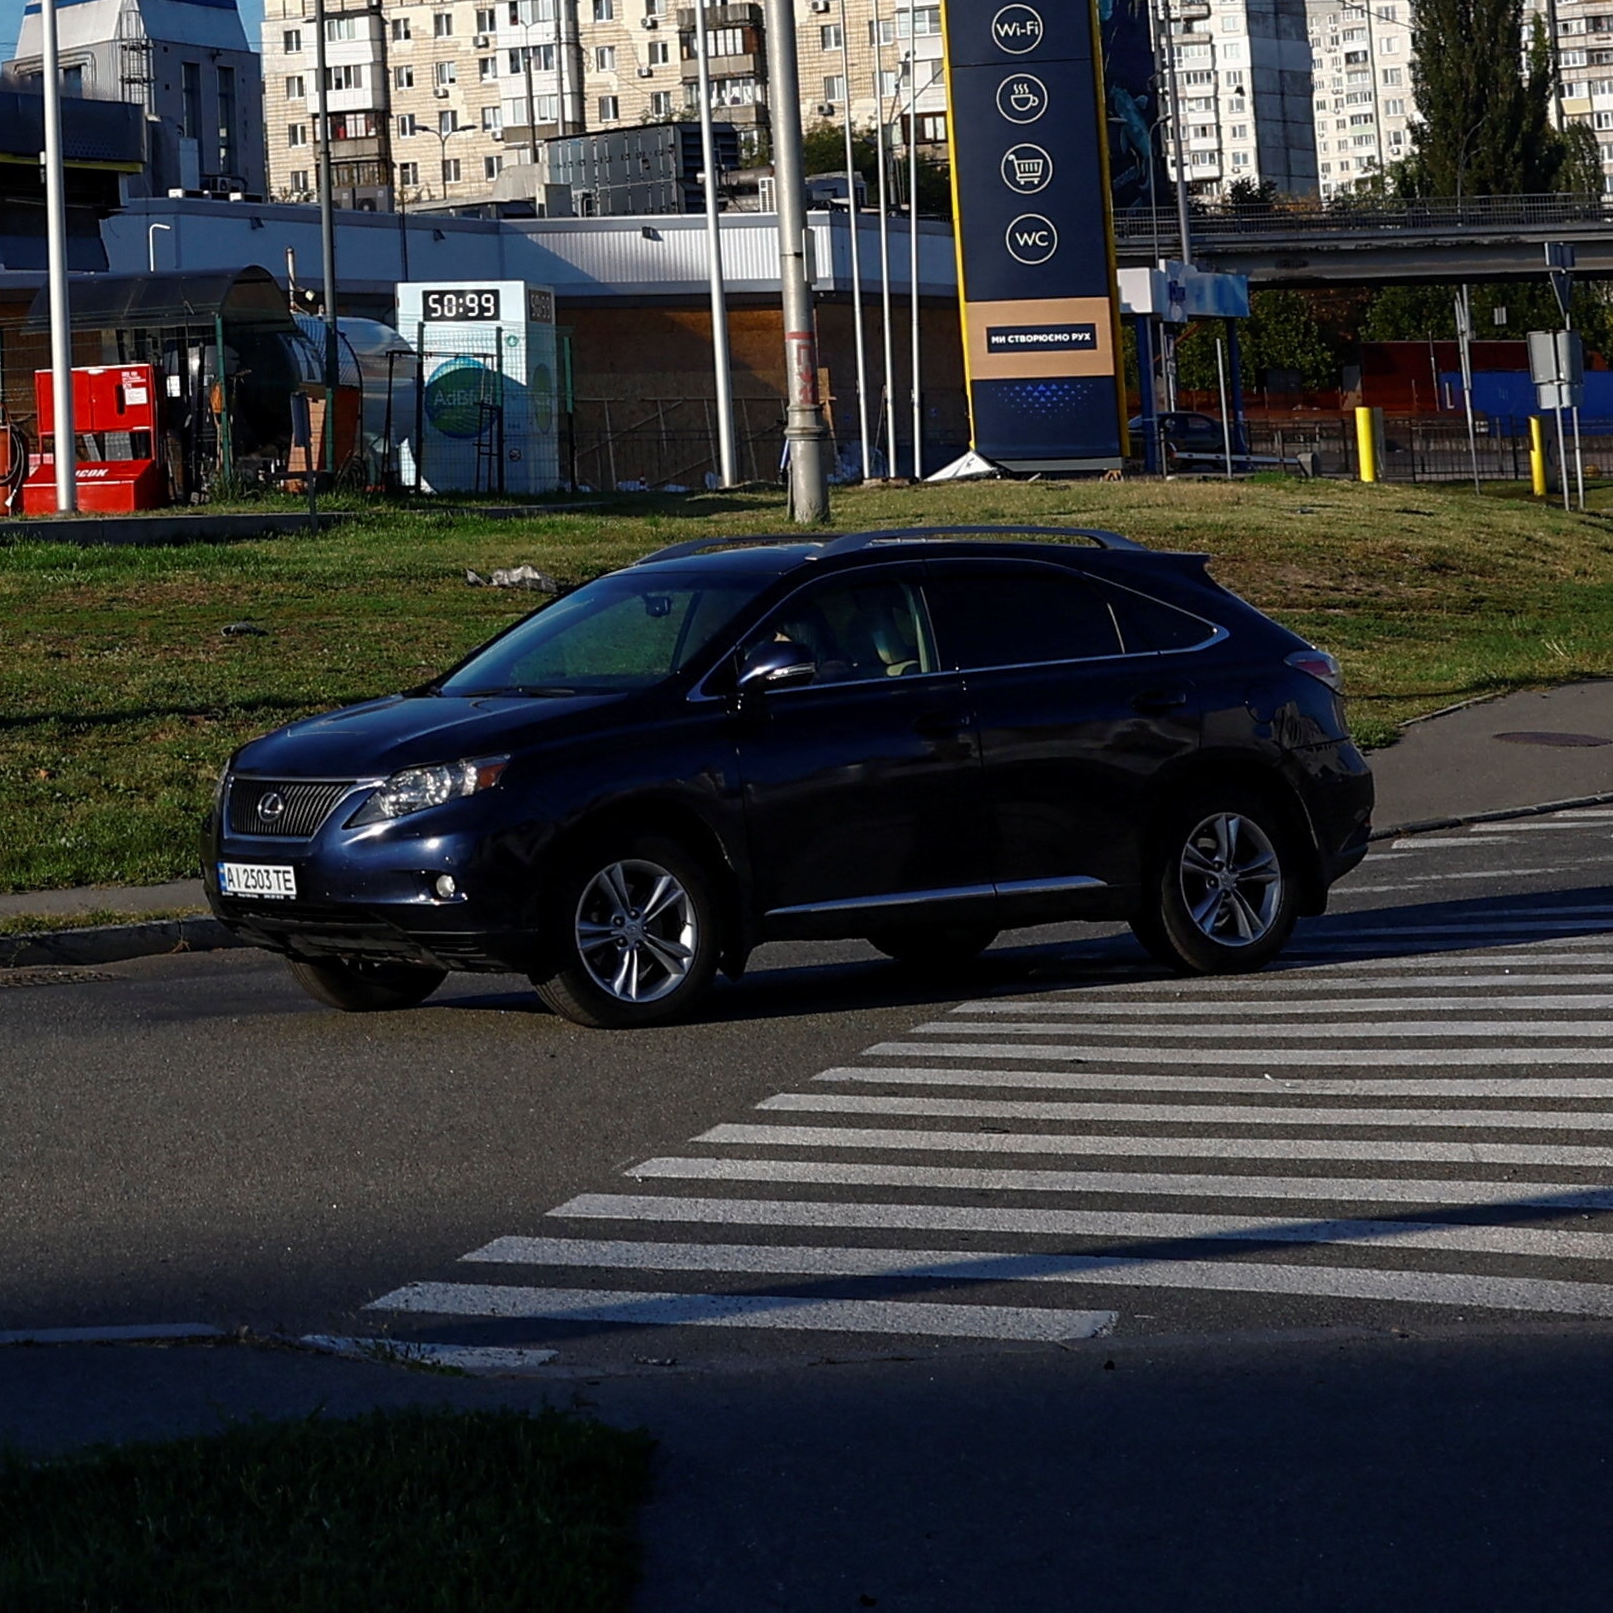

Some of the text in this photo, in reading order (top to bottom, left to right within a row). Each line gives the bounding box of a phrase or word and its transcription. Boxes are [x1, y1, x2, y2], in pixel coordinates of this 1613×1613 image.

[996, 20, 1040, 38] Wi-Fi
[1014, 230, 1050, 247] WC
[428, 293, 495, 318] 50:99
[990, 335, 1007, 345] МИ
[1071, 332, 1092, 342] РУХ
[227, 866, 294, 892] AI 2503 TE
